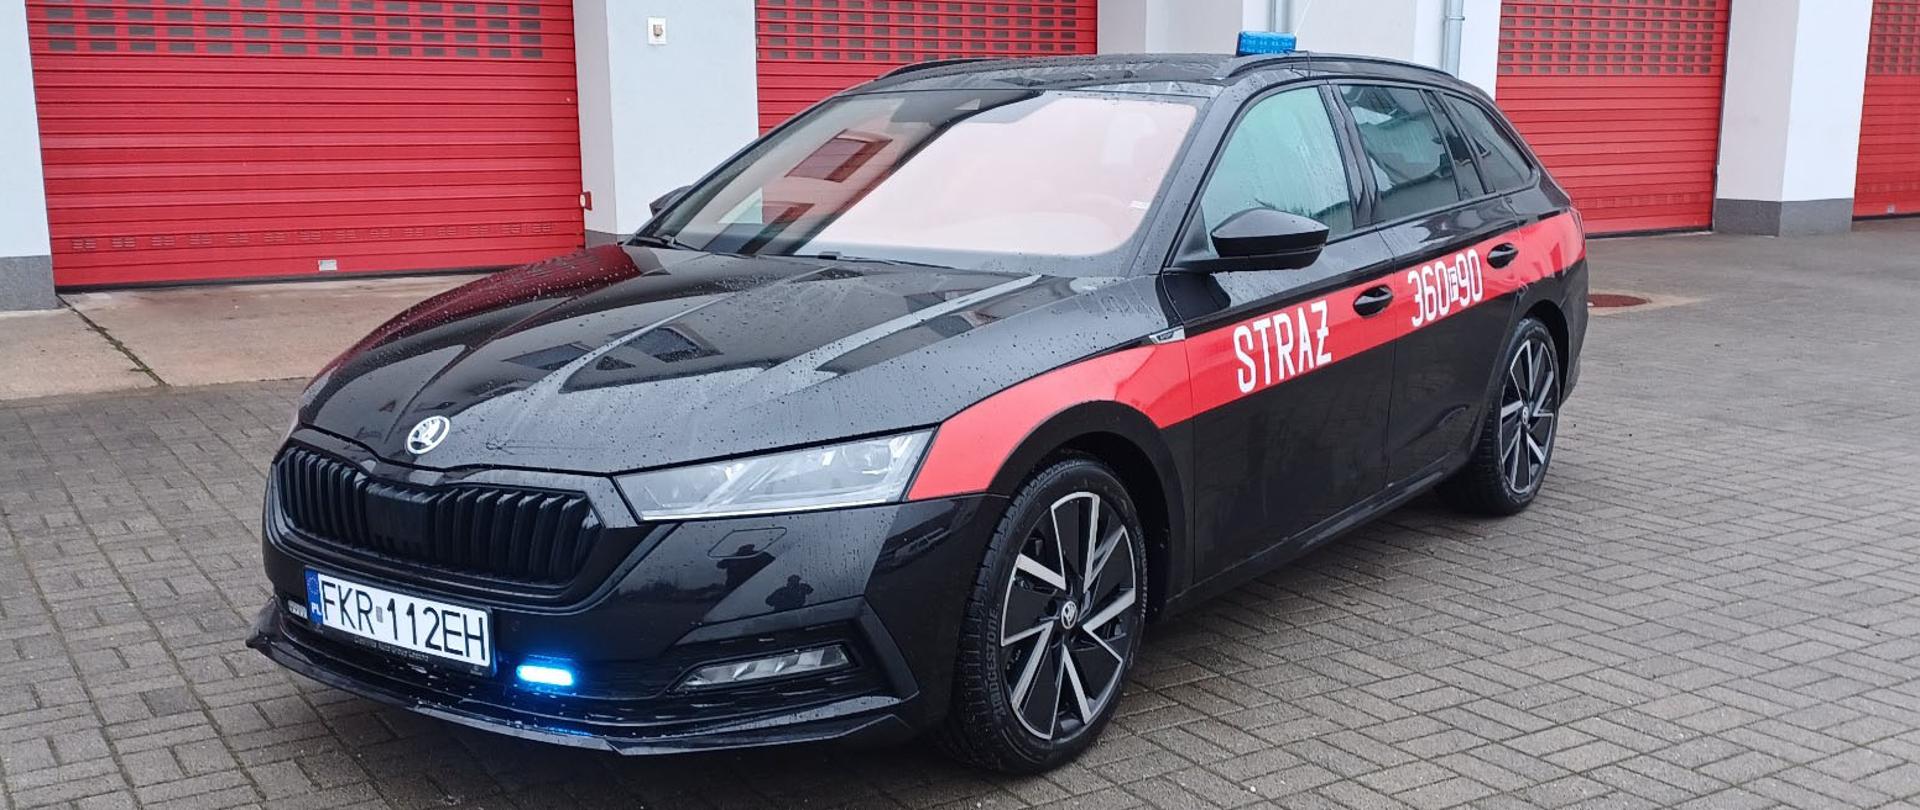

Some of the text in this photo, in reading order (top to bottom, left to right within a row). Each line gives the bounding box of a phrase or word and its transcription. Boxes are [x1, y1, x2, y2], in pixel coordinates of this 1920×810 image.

[311, 602, 322, 616] PL
[321, 580, 375, 635] FKR
[387, 598, 485, 661] 112EH
